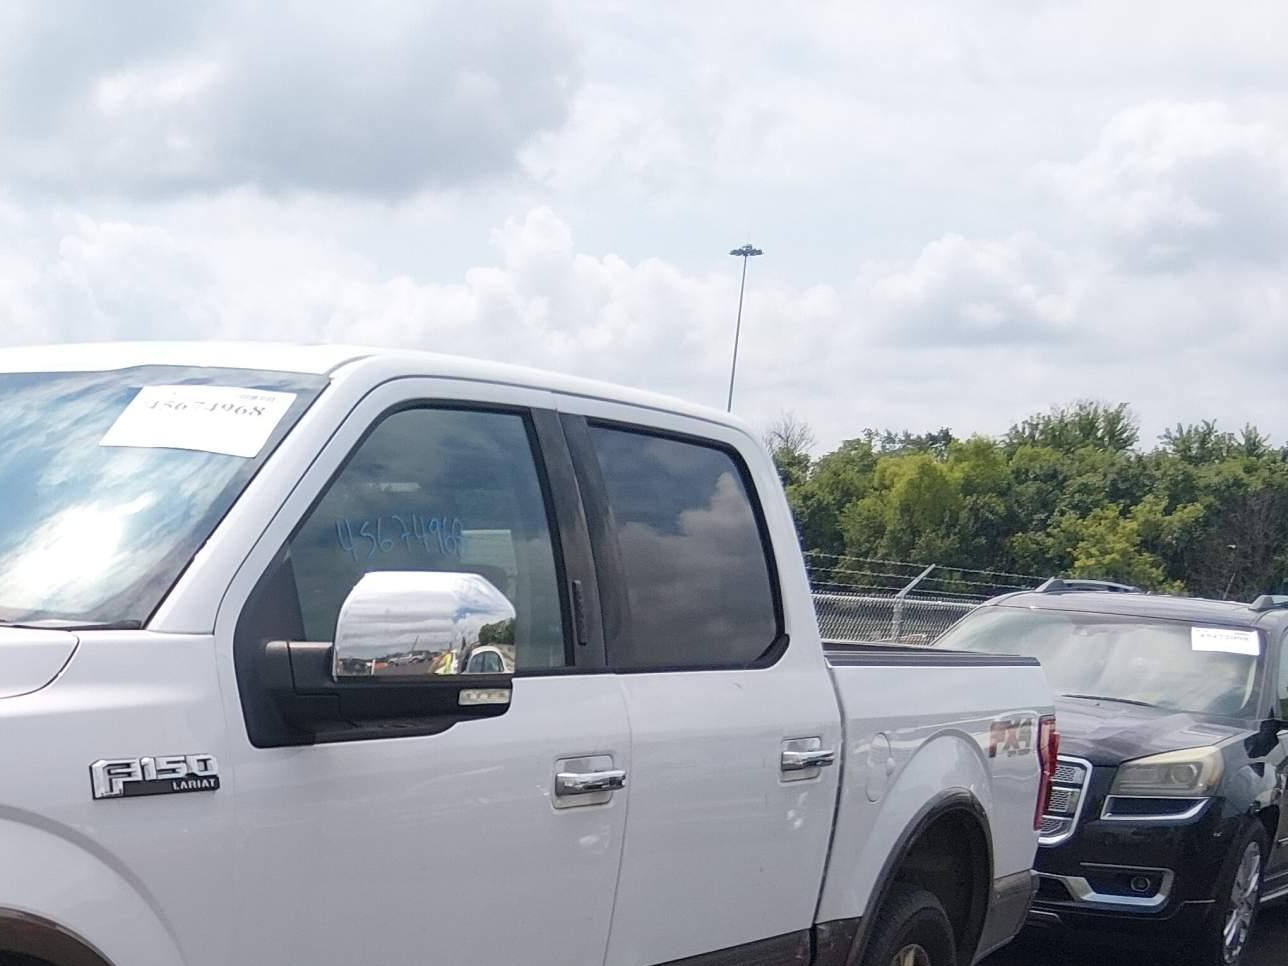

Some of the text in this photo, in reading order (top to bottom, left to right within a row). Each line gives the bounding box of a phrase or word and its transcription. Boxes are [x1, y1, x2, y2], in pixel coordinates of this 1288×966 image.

[335, 514, 462, 562] 45674968
[989, 718, 1032, 758] FX4
[172, 778, 216, 791] LARIAT
